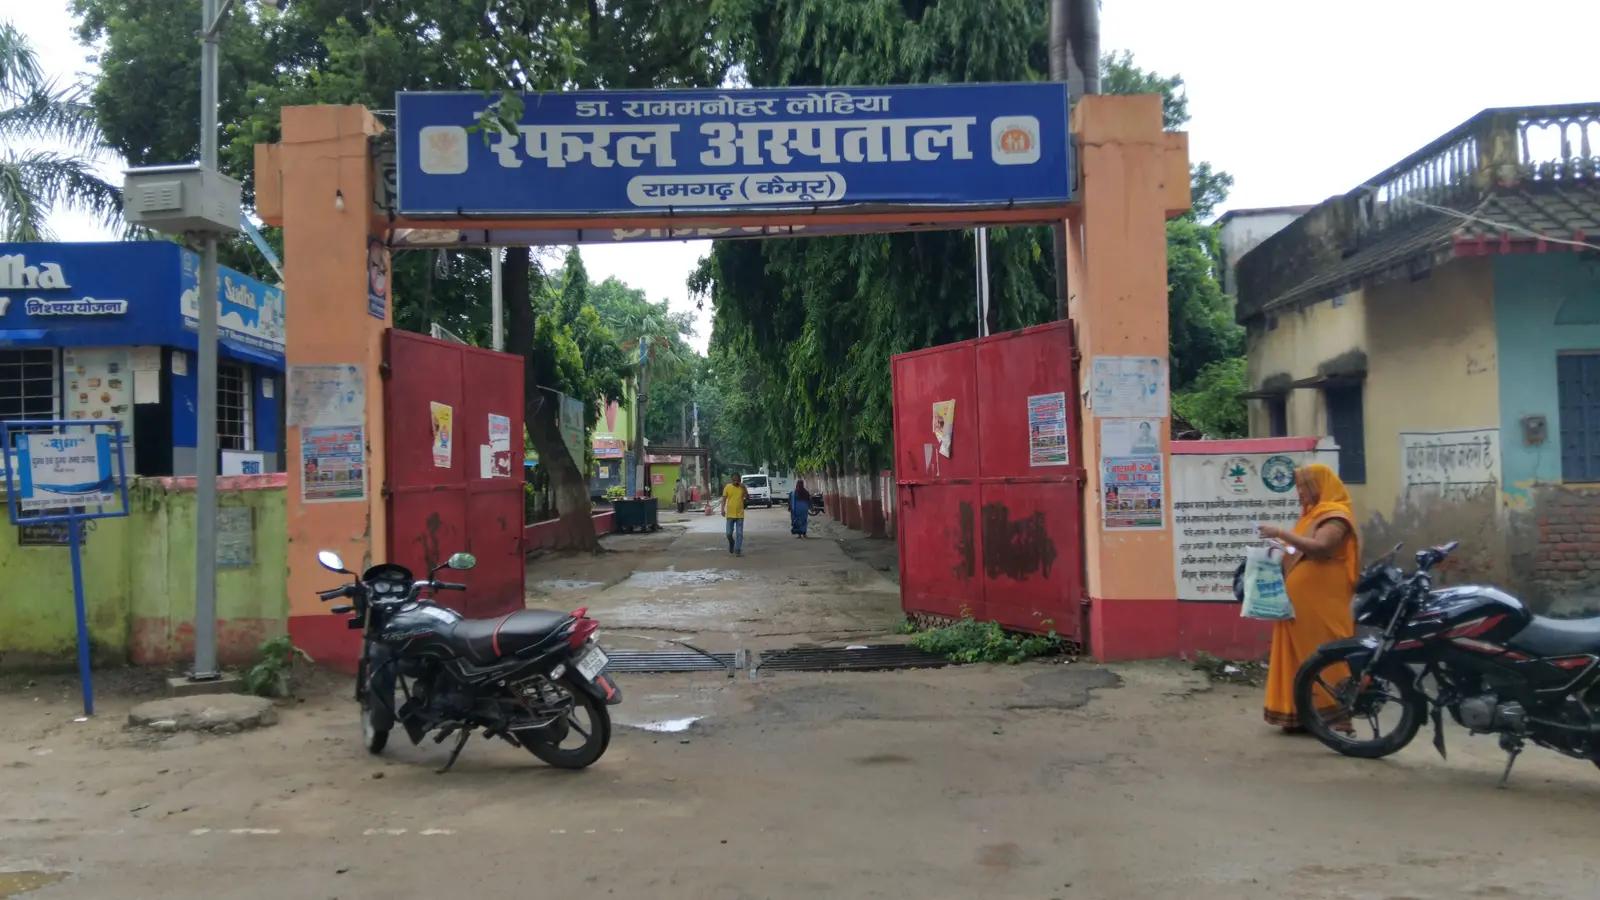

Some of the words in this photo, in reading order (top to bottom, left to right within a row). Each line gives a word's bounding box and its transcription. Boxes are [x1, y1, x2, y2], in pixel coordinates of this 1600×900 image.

[575, 100, 613, 117] डा.
[622, 95, 779, 118] राममनोहर
[786, 93, 892, 115] लोहिया
[699, 116, 977, 166] अस्पताल
[641, 181, 736, 200] रामगढ़
[27, 300, 75, 314] निश्चय
[75, 299, 122, 314] योजना
